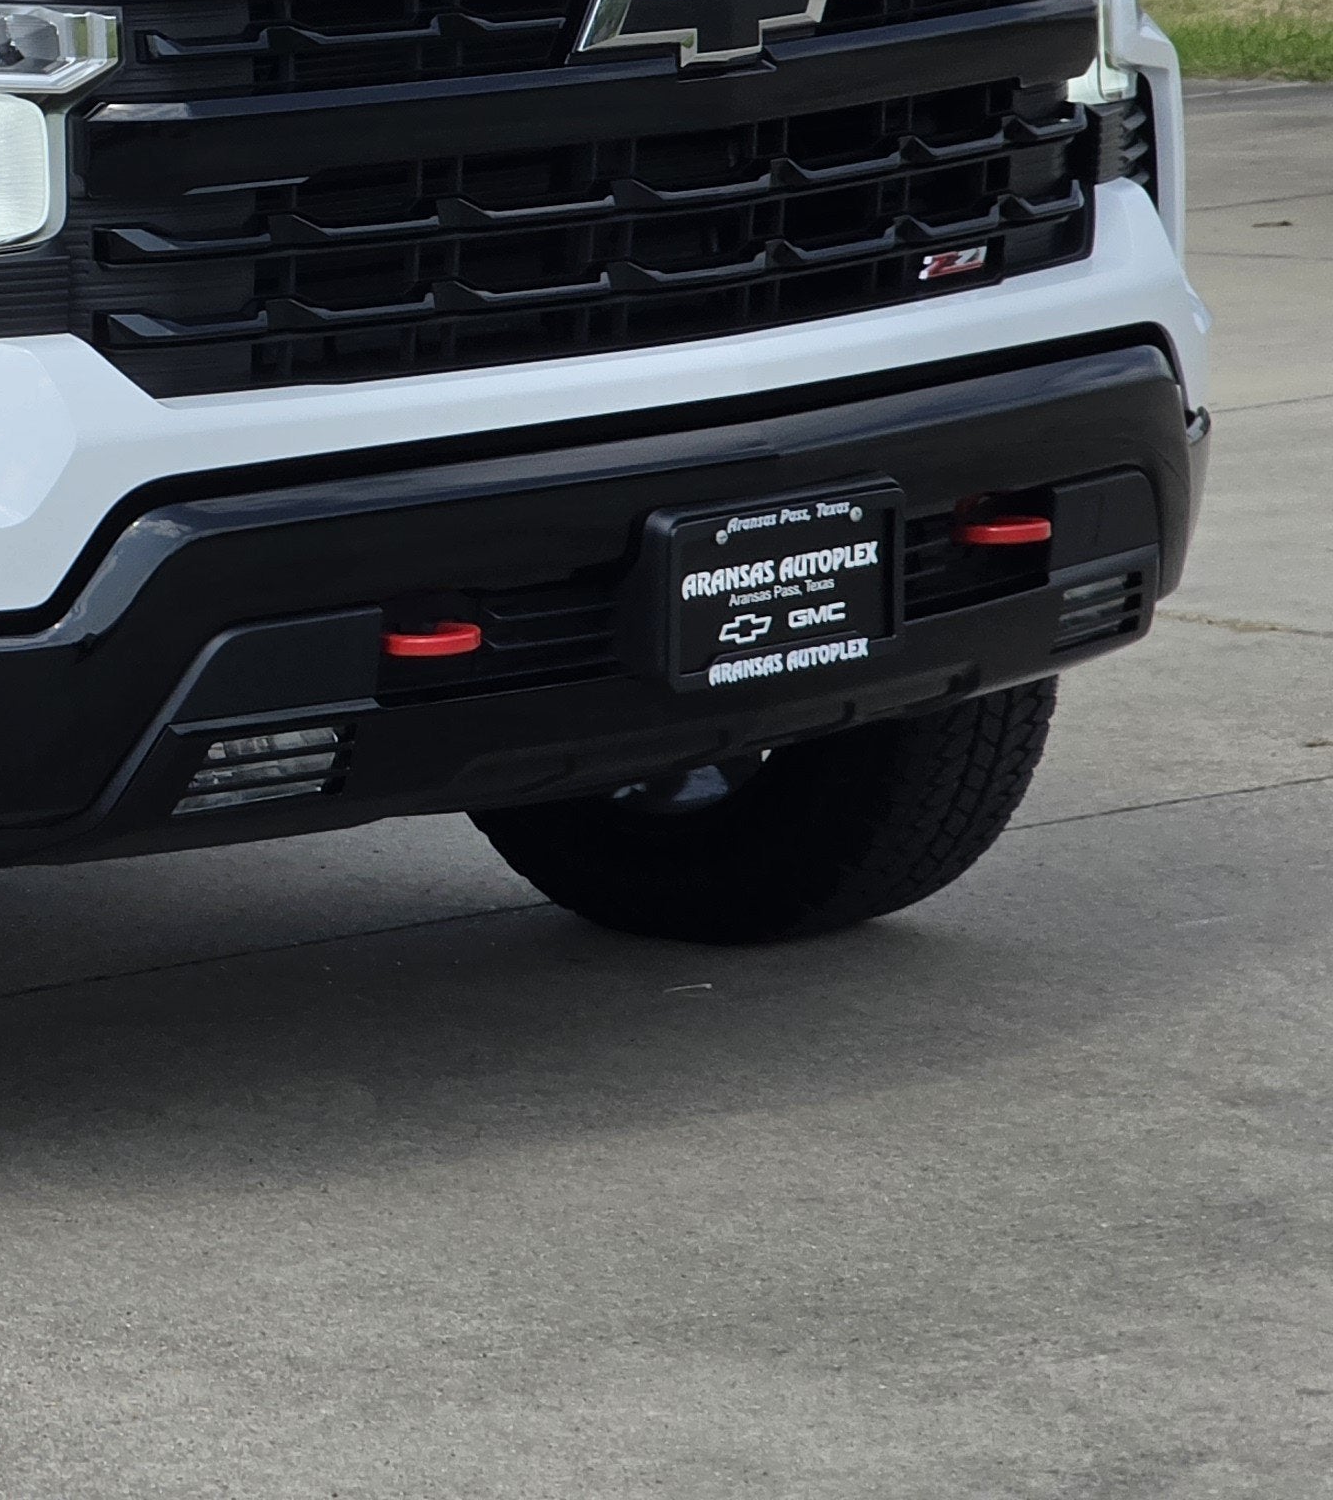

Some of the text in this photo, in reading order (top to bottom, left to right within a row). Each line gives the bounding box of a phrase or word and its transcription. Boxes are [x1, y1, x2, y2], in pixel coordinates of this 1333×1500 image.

[918, 246, 987, 280] Z71
[727, 501, 850, 534] Aransas Pass, Texas
[682, 541, 878, 600] ARANSAS AUTOPLEX
[728, 578, 835, 608] Aransas Pass, Texas
[788, 602, 846, 629] GMC
[708, 638, 869, 687] ARANSAS AUTOPLEX
